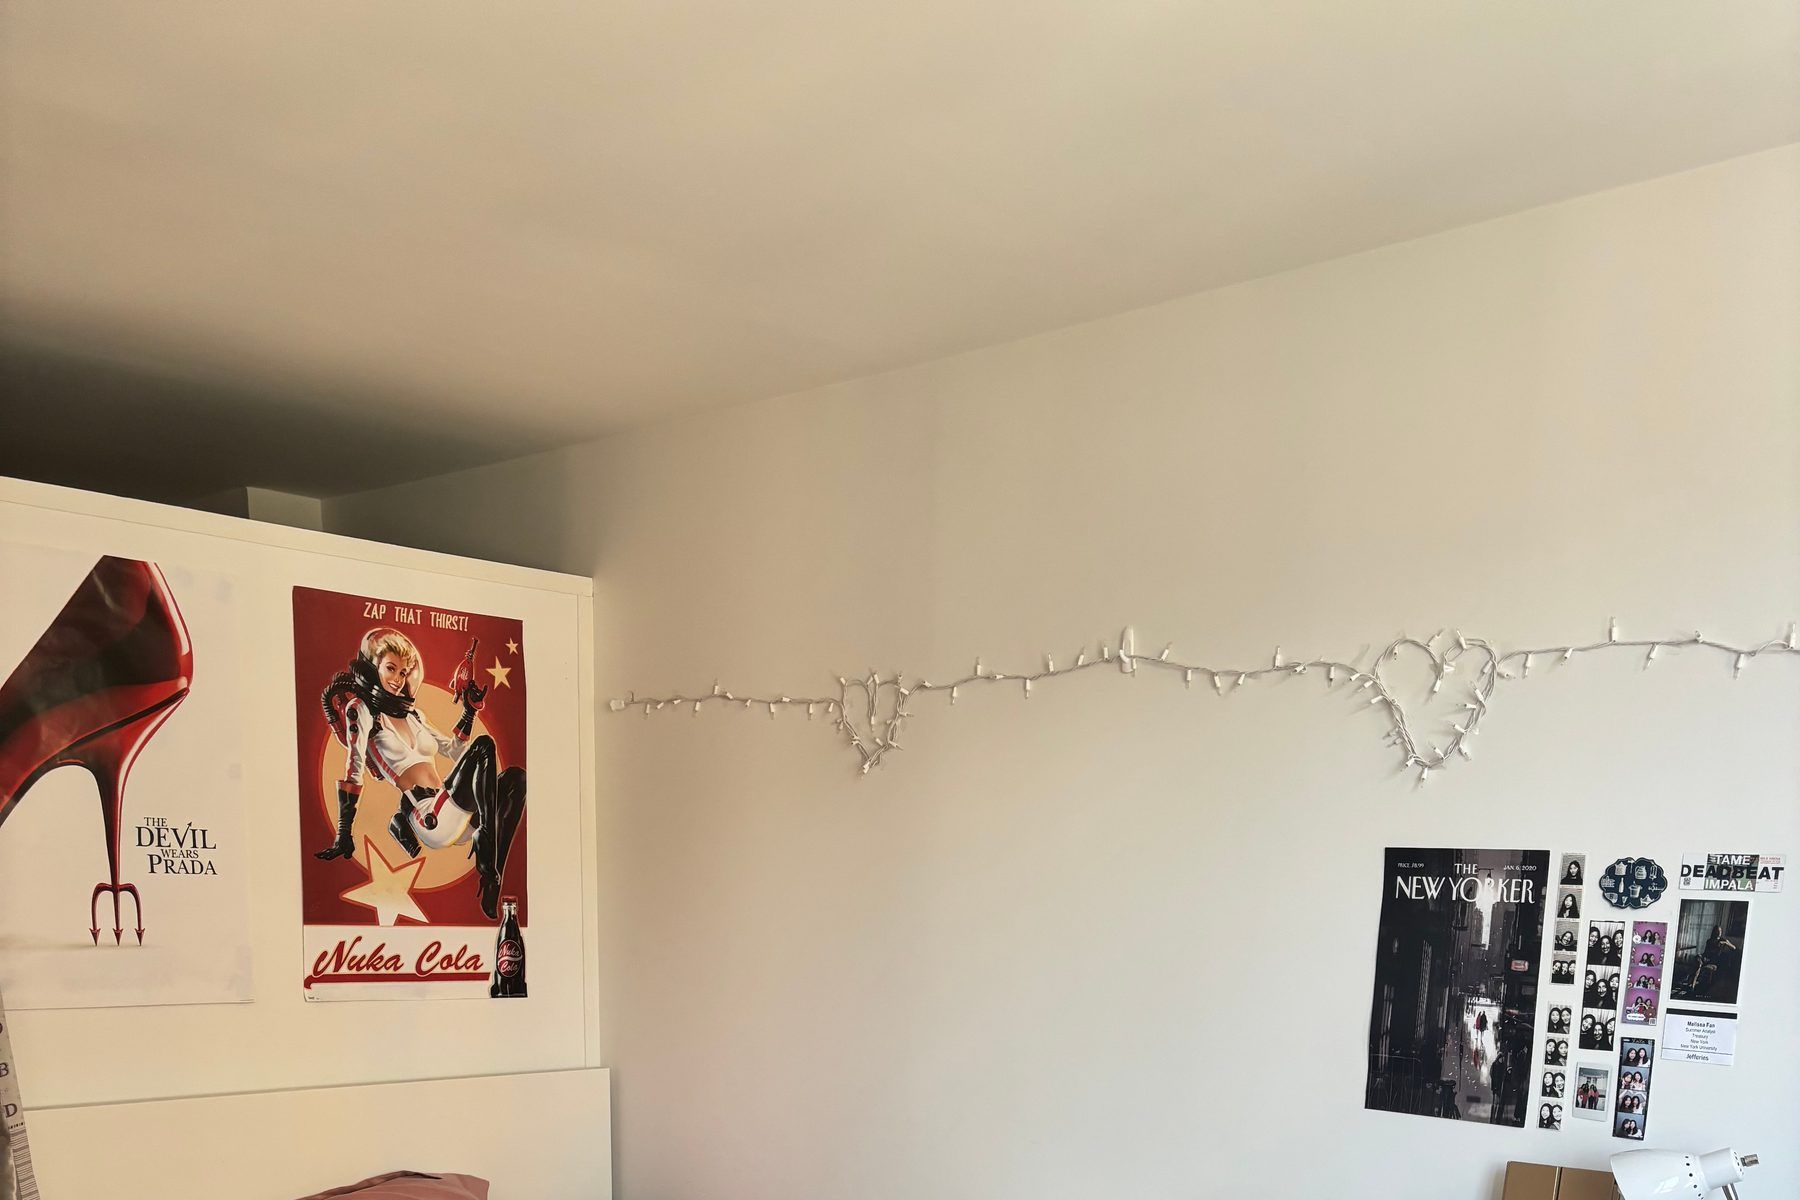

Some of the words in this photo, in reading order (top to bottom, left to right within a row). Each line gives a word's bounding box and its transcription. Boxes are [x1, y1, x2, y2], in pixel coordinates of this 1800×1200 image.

[363, 602, 386, 620] ZAP
[394, 606, 422, 624] THAT
[430, 611, 469, 631] THIRST!
[144, 816, 167, 827] THE
[135, 822, 217, 849] DEVIL
[160, 849, 199, 859] WEARS
[1715, 854, 1751, 865] TAME
[147, 854, 218, 875] PRADA
[1454, 863, 1478, 875] THE
[1680, 864, 1785, 880] DEADBEAT
[1395, 876, 1446, 900] NEW
[1448, 877, 1536, 904] YORKER
[1704, 879, 1754, 891] IMPALA
[312, 936, 404, 977] Nuka
[415, 940, 484, 976] Cola
[498, 943, 520, 959] Nuka
[500, 960, 518, 973] Cola
[1686, 1053, 1709, 1061] Jefferies
